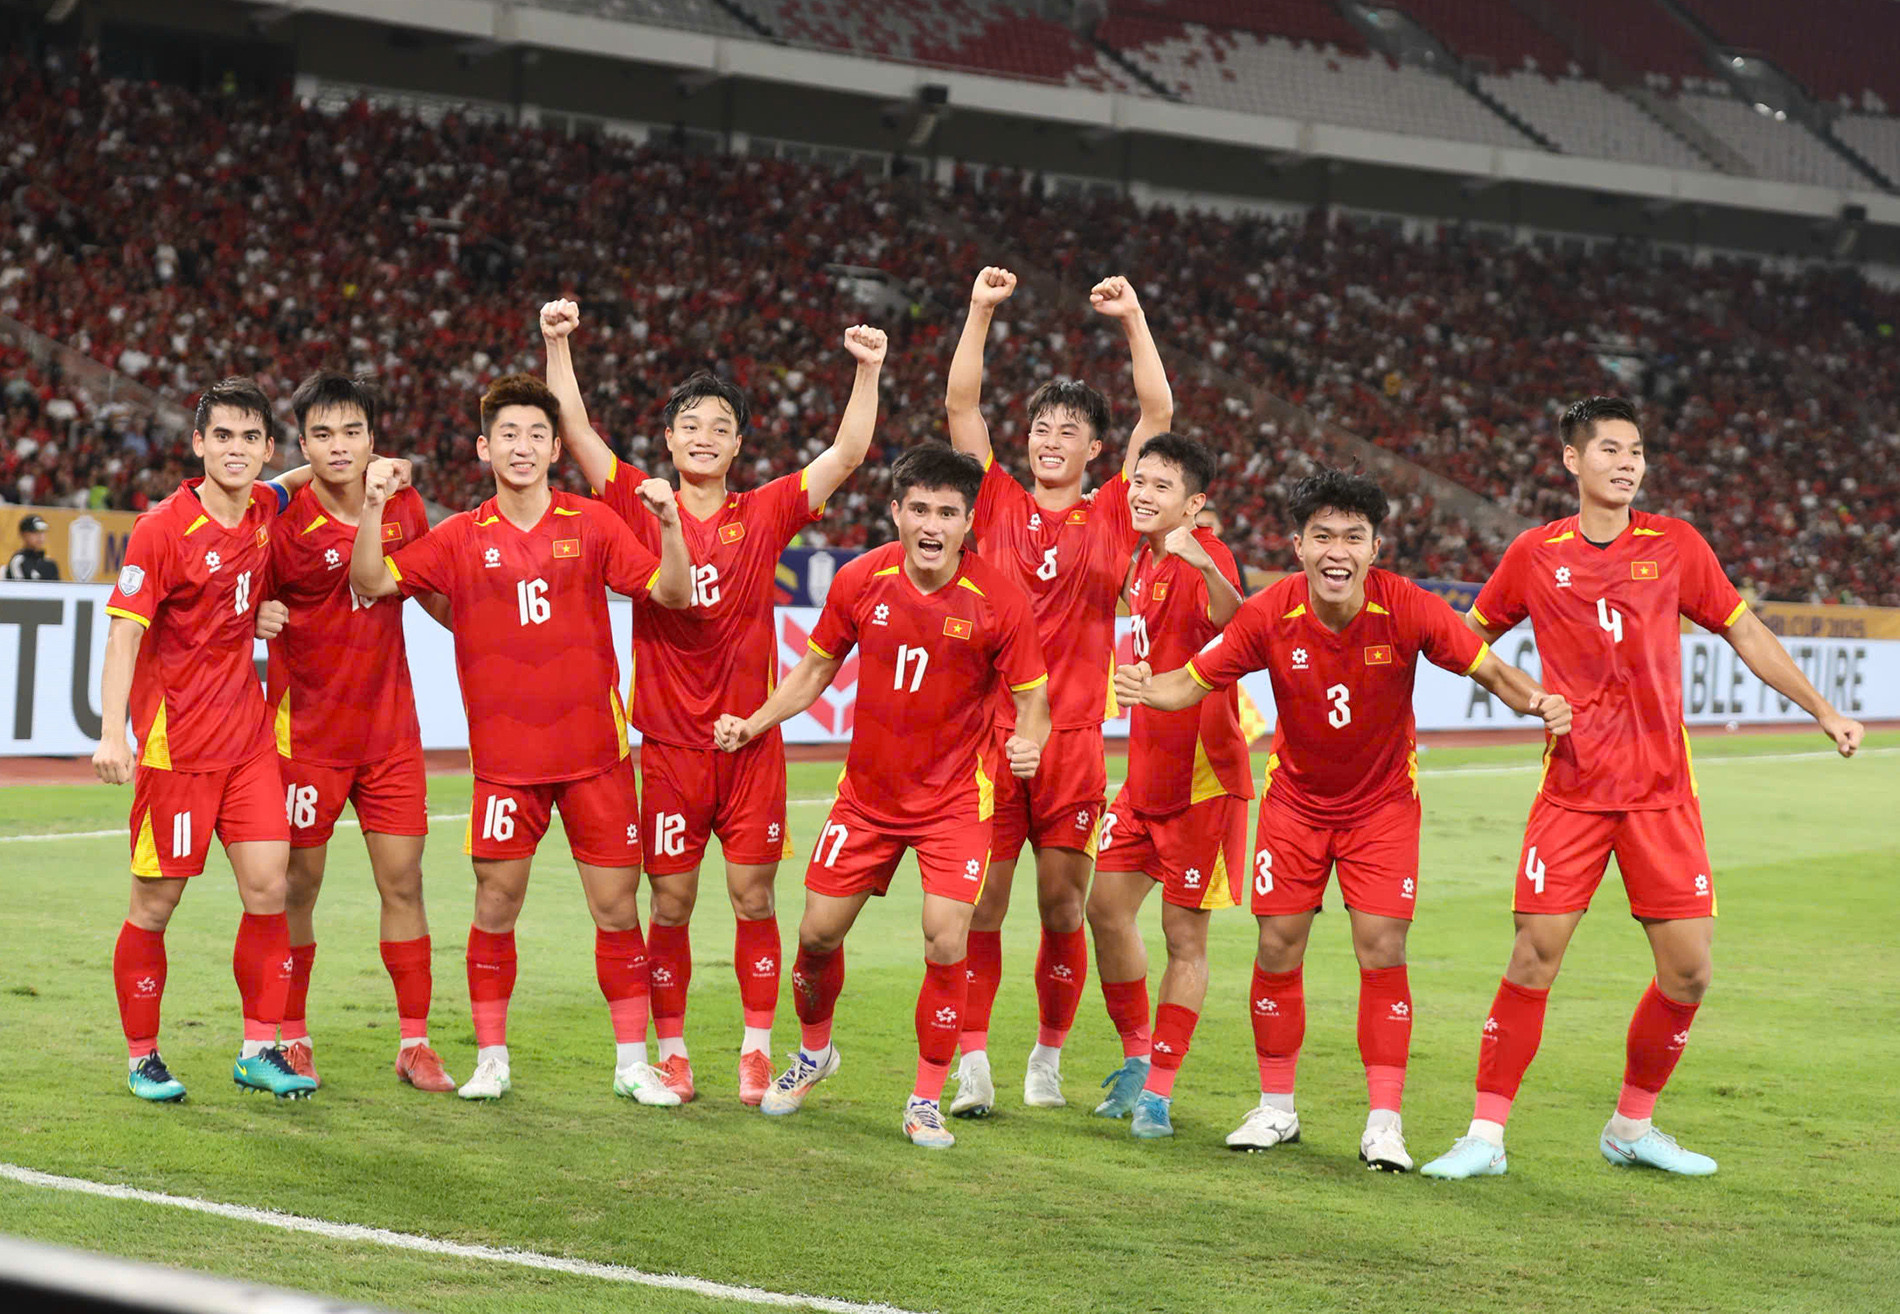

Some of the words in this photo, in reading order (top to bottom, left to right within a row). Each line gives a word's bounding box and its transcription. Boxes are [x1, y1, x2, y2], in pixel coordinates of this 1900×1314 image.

[234, 570, 252, 616] 11
[517, 577, 551, 626] 16
[689, 563, 721, 608] 12
[1596, 597, 1623, 643] 4
[893, 644, 929, 693] 17
[1326, 683, 1351, 729] 3
[285, 783, 318, 829] 18
[482, 795, 518, 842] 16
[173, 811, 191, 858] 11
[654, 811, 686, 857] 12
[813, 819, 849, 868] 17
[1255, 848, 1274, 896] 3
[1525, 846, 1546, 894] 4
